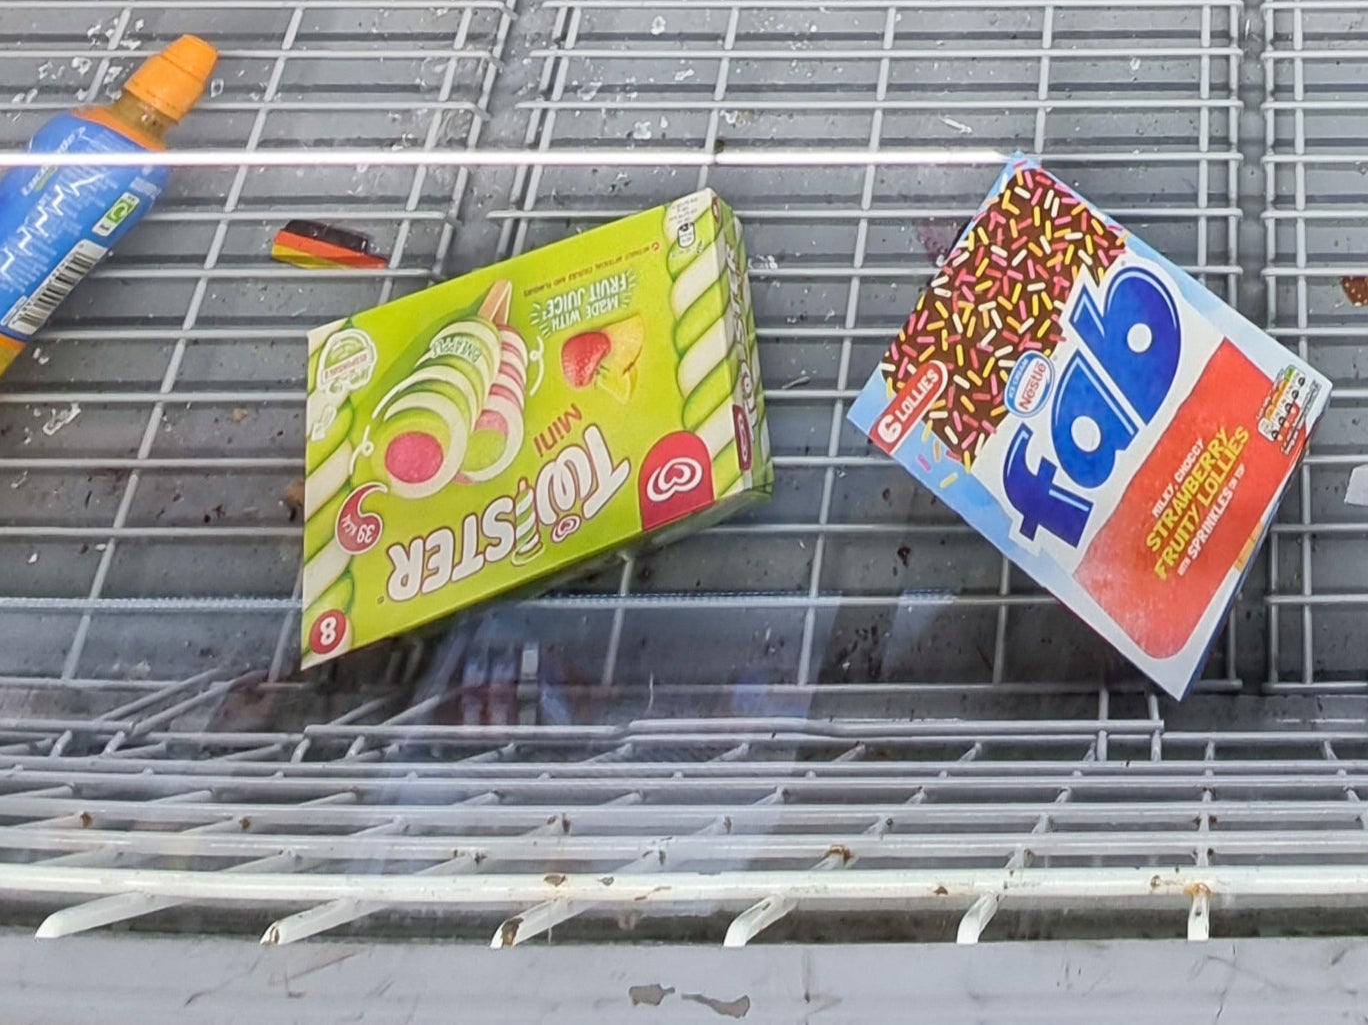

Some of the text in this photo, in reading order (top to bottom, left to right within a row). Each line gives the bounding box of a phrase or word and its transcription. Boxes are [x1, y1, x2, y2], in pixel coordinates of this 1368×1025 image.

[588, 273, 627, 302] FRUIT
[551, 311, 581, 332] WITH
[877, 368, 940, 444] 6 LOLLIES
[1002, 265, 1183, 549] fab
[1146, 426, 1229, 552] STRAWBERRY
[1173, 437, 1205, 484] CHOCCY
[1154, 425, 1250, 582] FRUITY LOLLIES
[1187, 486, 1234, 560] SPRINKLES
[357, 523, 376, 545] 39
[319, 616, 338, 647] 8
